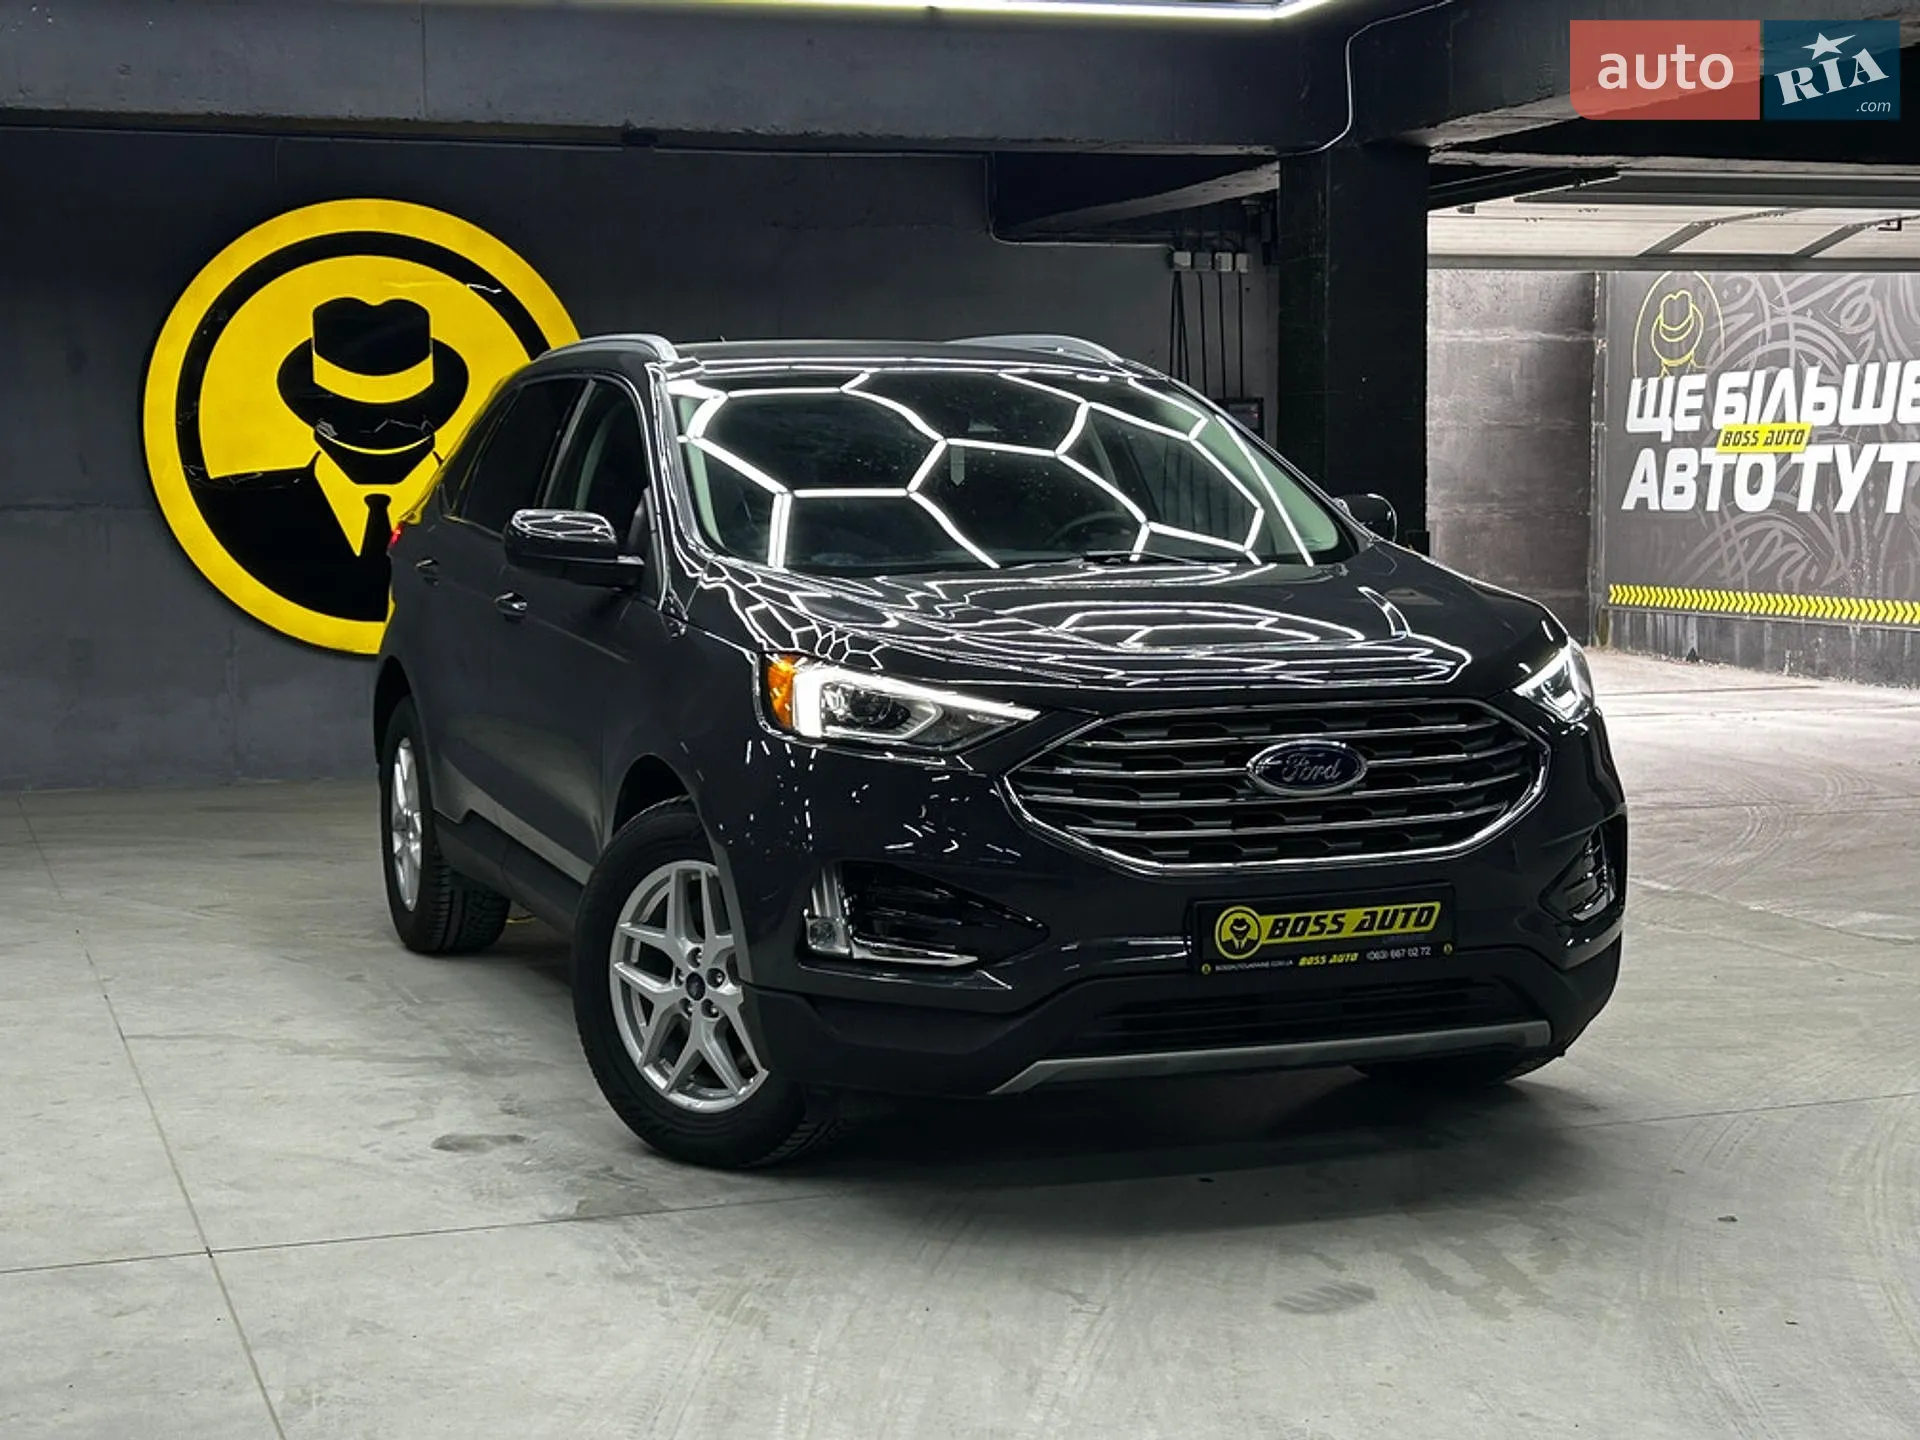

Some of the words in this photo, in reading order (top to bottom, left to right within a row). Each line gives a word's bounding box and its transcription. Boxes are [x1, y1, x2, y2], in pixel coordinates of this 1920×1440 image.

[1626, 373, 1707, 443] ЩЕ
[1712, 360, 1920, 430] БІЛЬШЕ
[1721, 430, 1759, 447] BOSS
[1763, 428, 1806, 446] AUTO
[1621, 448, 1777, 512] АВТО
[1788, 441, 1920, 513] ТУТ
[1282, 753, 1342, 782] Ford
[1266, 912, 1346, 940] BOSS
[1352, 905, 1436, 933] AUTO
[1298, 955, 1327, 967] BOSS
